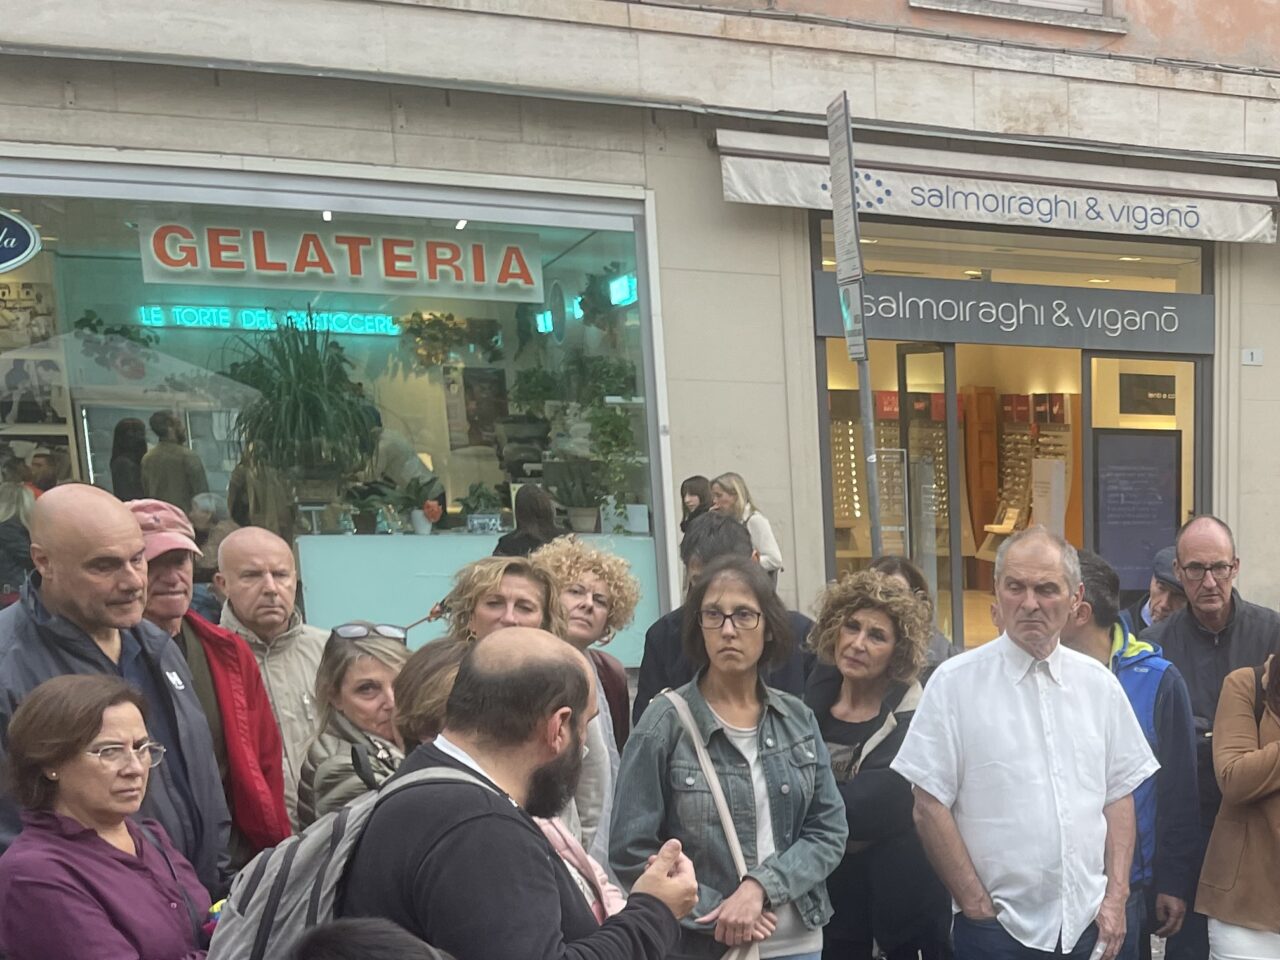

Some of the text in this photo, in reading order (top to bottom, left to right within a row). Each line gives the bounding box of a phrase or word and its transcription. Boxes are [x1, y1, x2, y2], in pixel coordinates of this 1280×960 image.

[911, 184, 1077, 223] salmoiraghi
[1085, 196, 1104, 221] &
[152, 224, 535, 286] GELATERIA
[139, 305, 163, 326] LE
[172, 306, 230, 328] TORTE
[863, 291, 1044, 332] salmoiraghi
[1052, 299, 1073, 327] &
